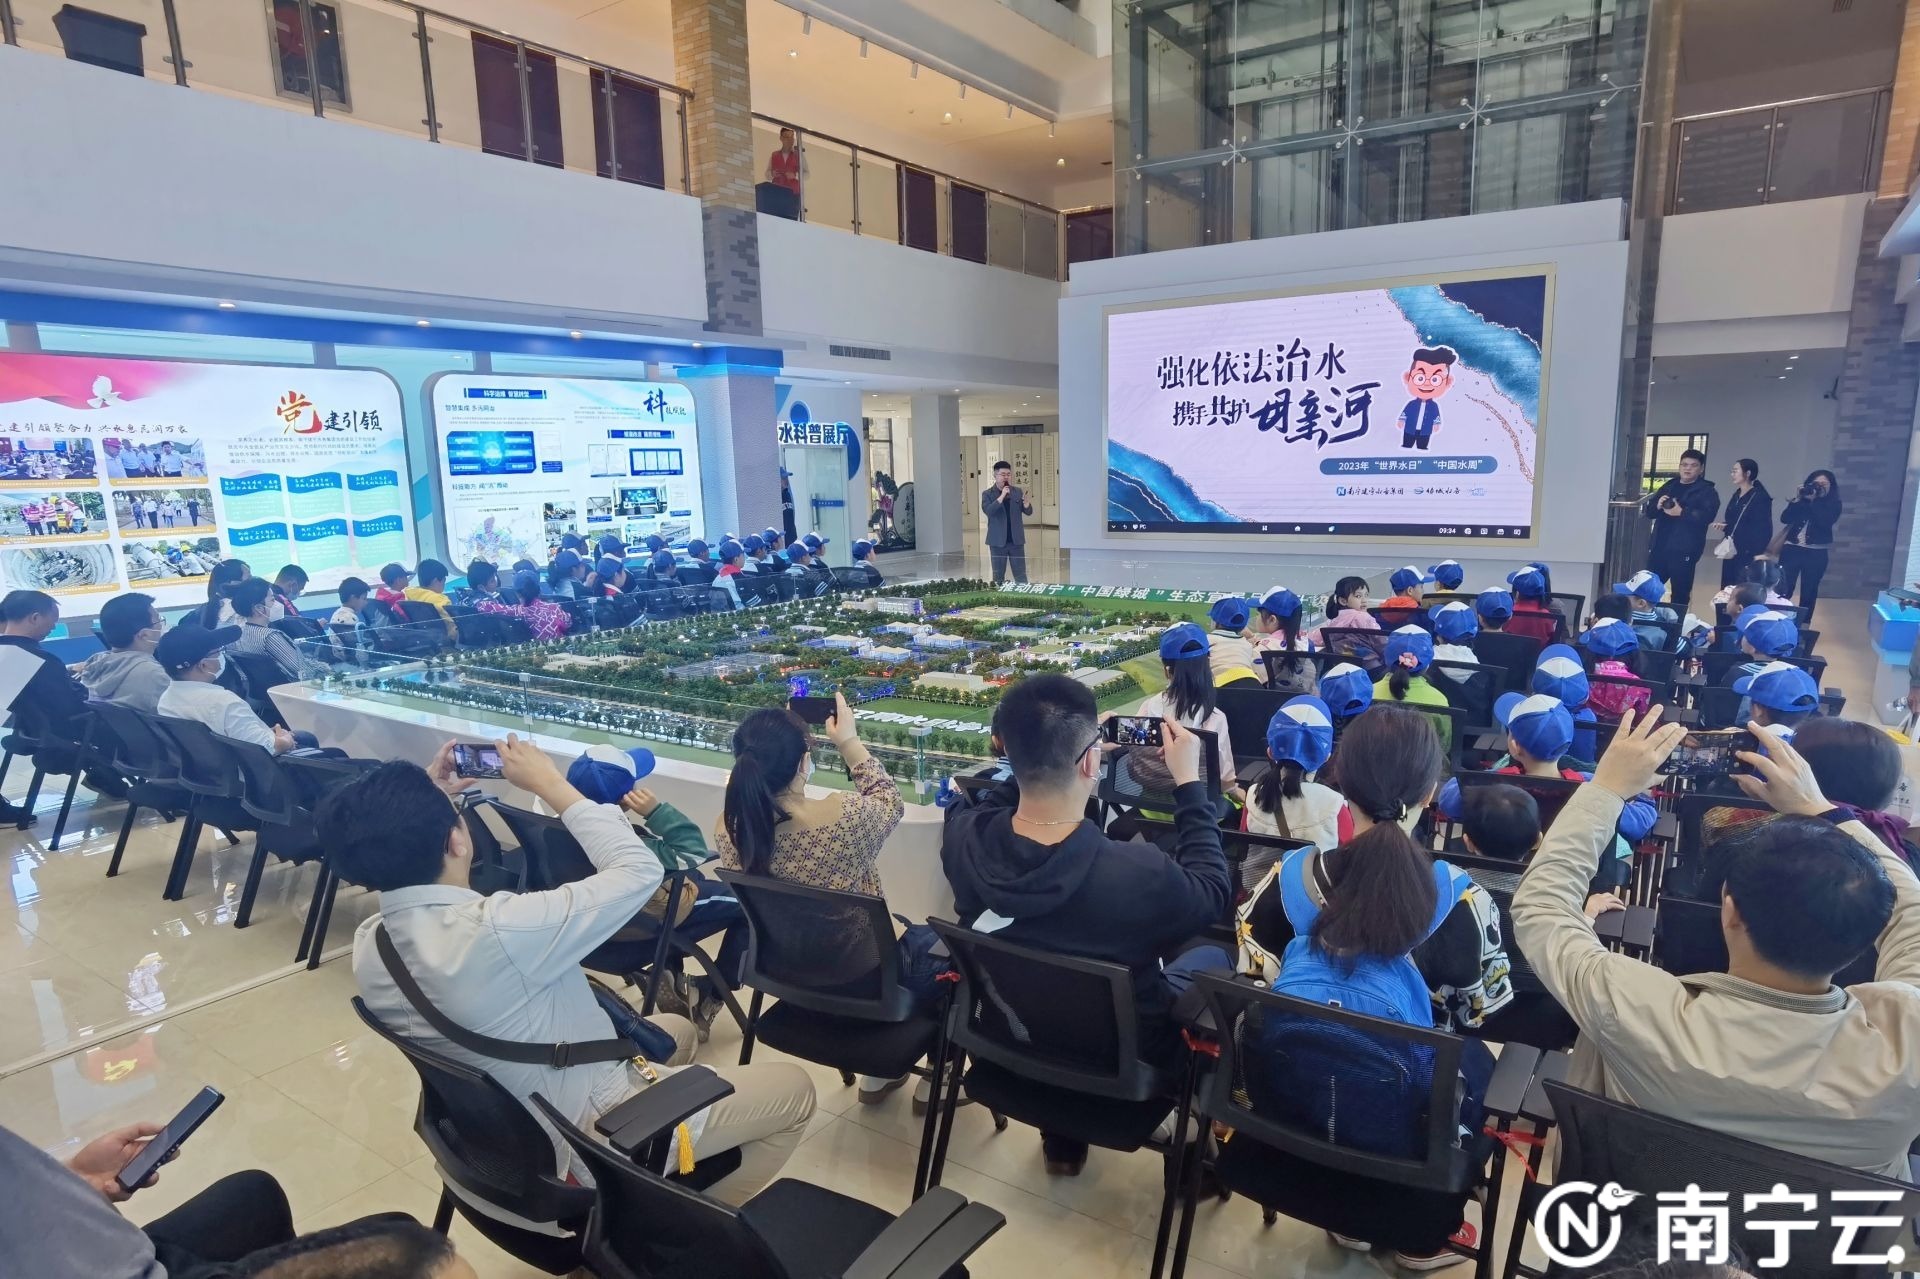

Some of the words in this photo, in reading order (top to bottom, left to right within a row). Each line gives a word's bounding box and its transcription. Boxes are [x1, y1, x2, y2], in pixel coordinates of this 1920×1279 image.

[1157, 338, 1346, 390] 强化依法治水
[778, 422, 849, 444] 水科普展厅
[1172, 382, 1382, 449] 携手共护母亲河
[1438, 527, 1457, 535] 09:34
